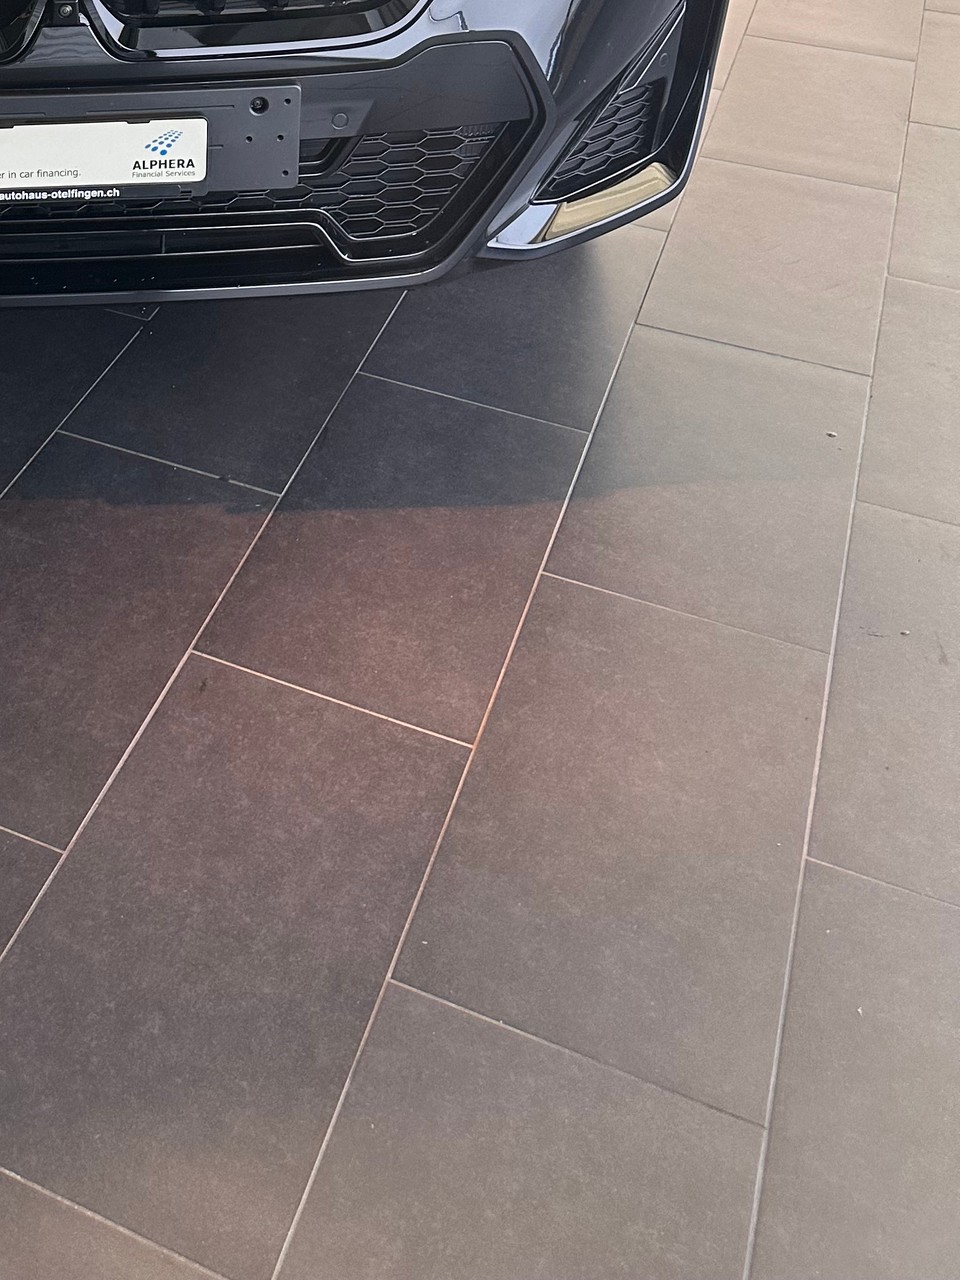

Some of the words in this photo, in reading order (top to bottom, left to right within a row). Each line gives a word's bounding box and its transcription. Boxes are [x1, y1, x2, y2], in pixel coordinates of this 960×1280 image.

[132, 158, 196, 170] ALPHERA
[8, 170, 17, 179] in
[19, 171, 34, 179] car
[36, 168, 82, 179] financing.
[131, 170, 163, 178] Financial
[165, 169, 196, 177] Services
